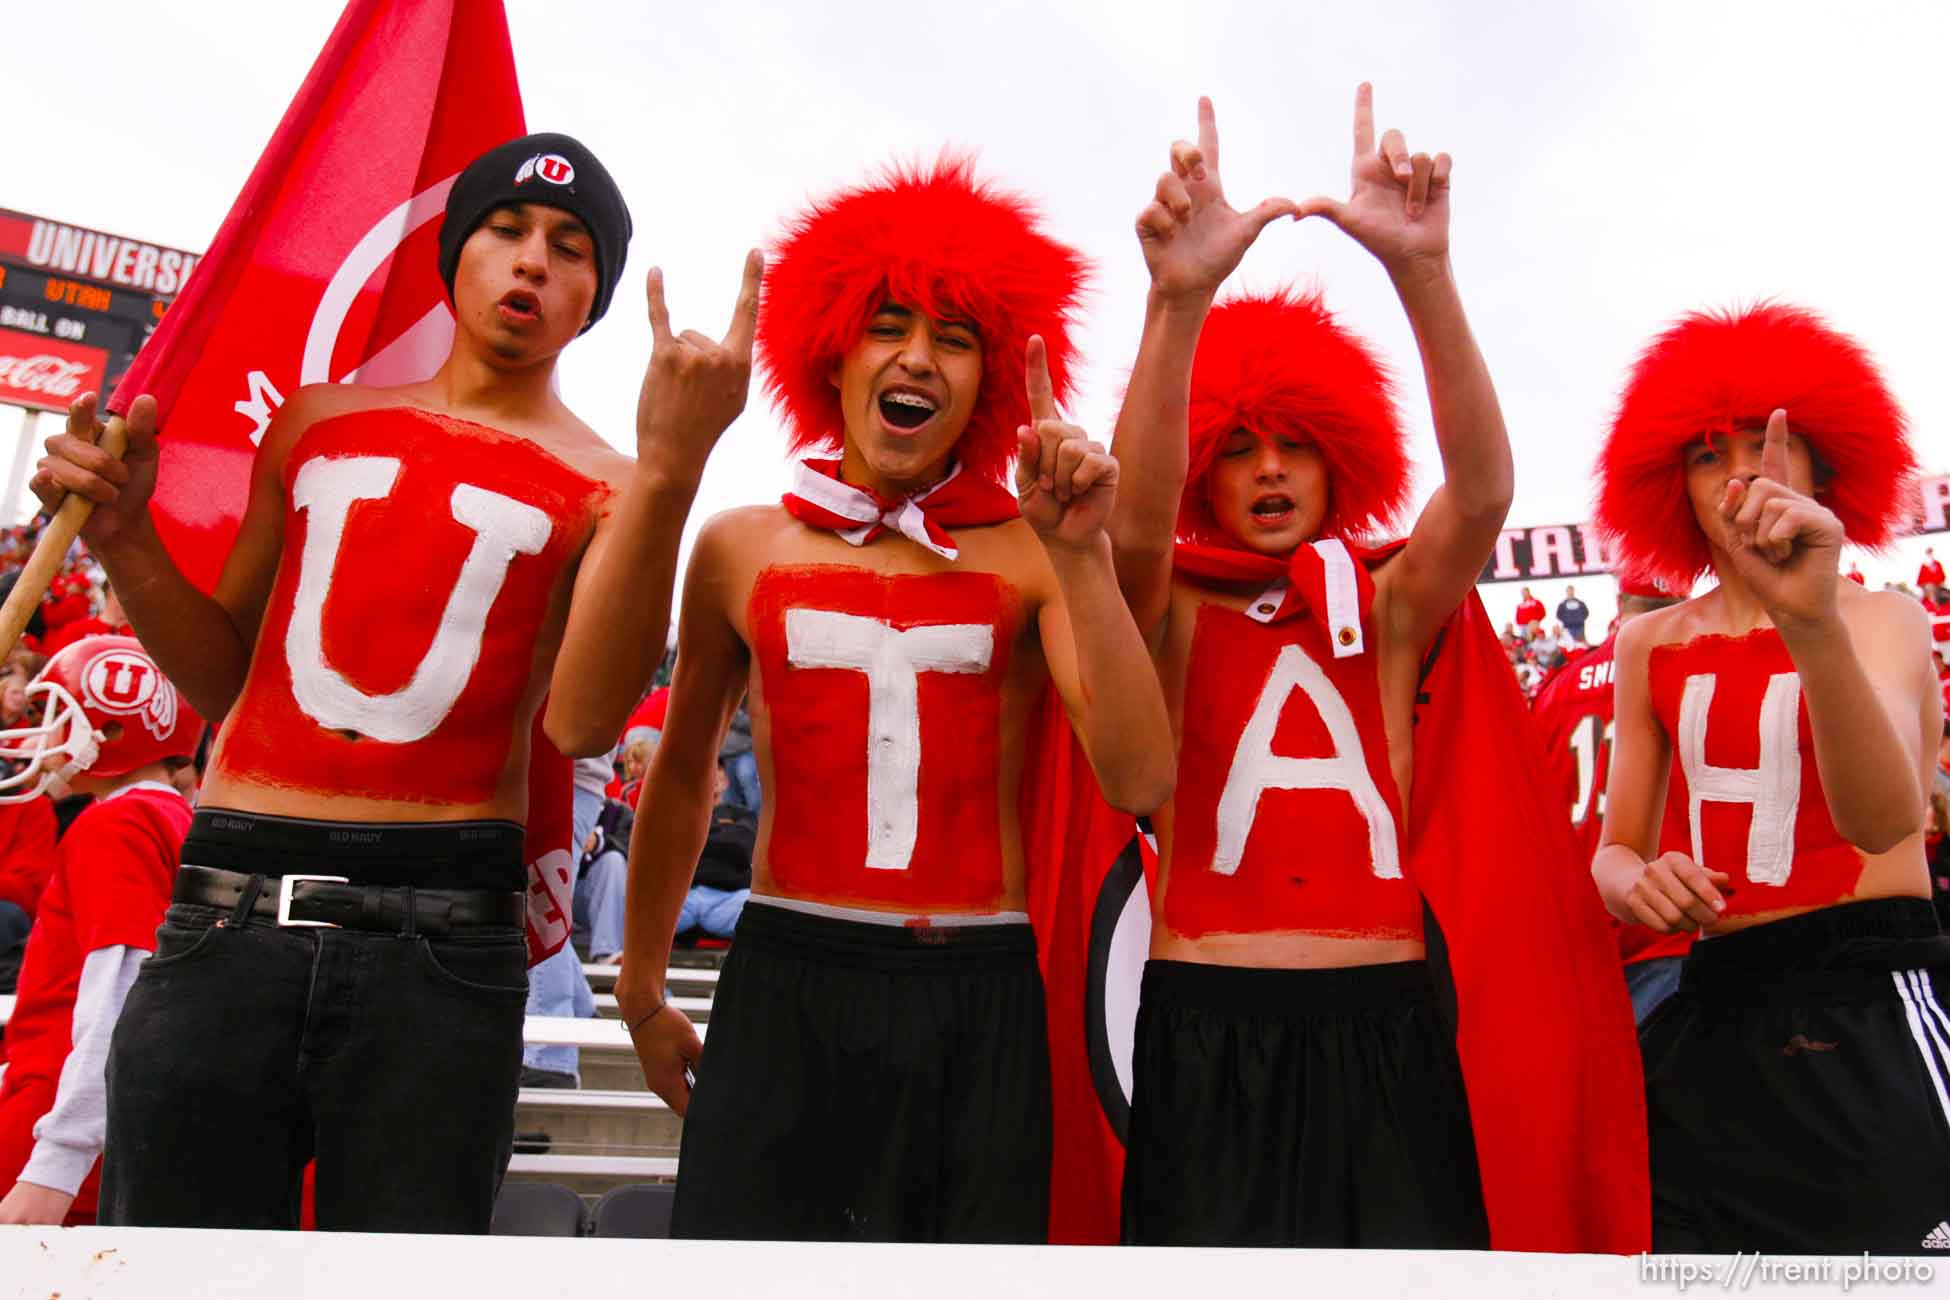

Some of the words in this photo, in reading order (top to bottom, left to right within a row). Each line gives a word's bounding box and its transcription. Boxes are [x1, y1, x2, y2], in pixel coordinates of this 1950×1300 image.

[543, 158, 571, 182] U
[44, 277, 112, 312] UTAH
[0, 304, 49, 334] BALL
[54, 317, 86, 341] ON
[285, 455, 553, 744] U
[102, 660, 148, 704] U
[785, 607, 995, 870] T
[1209, 643, 1404, 880] A
[1677, 671, 1802, 888] H
[329, 831, 350, 842] OLD
[351, 831, 383, 844] NAVY
